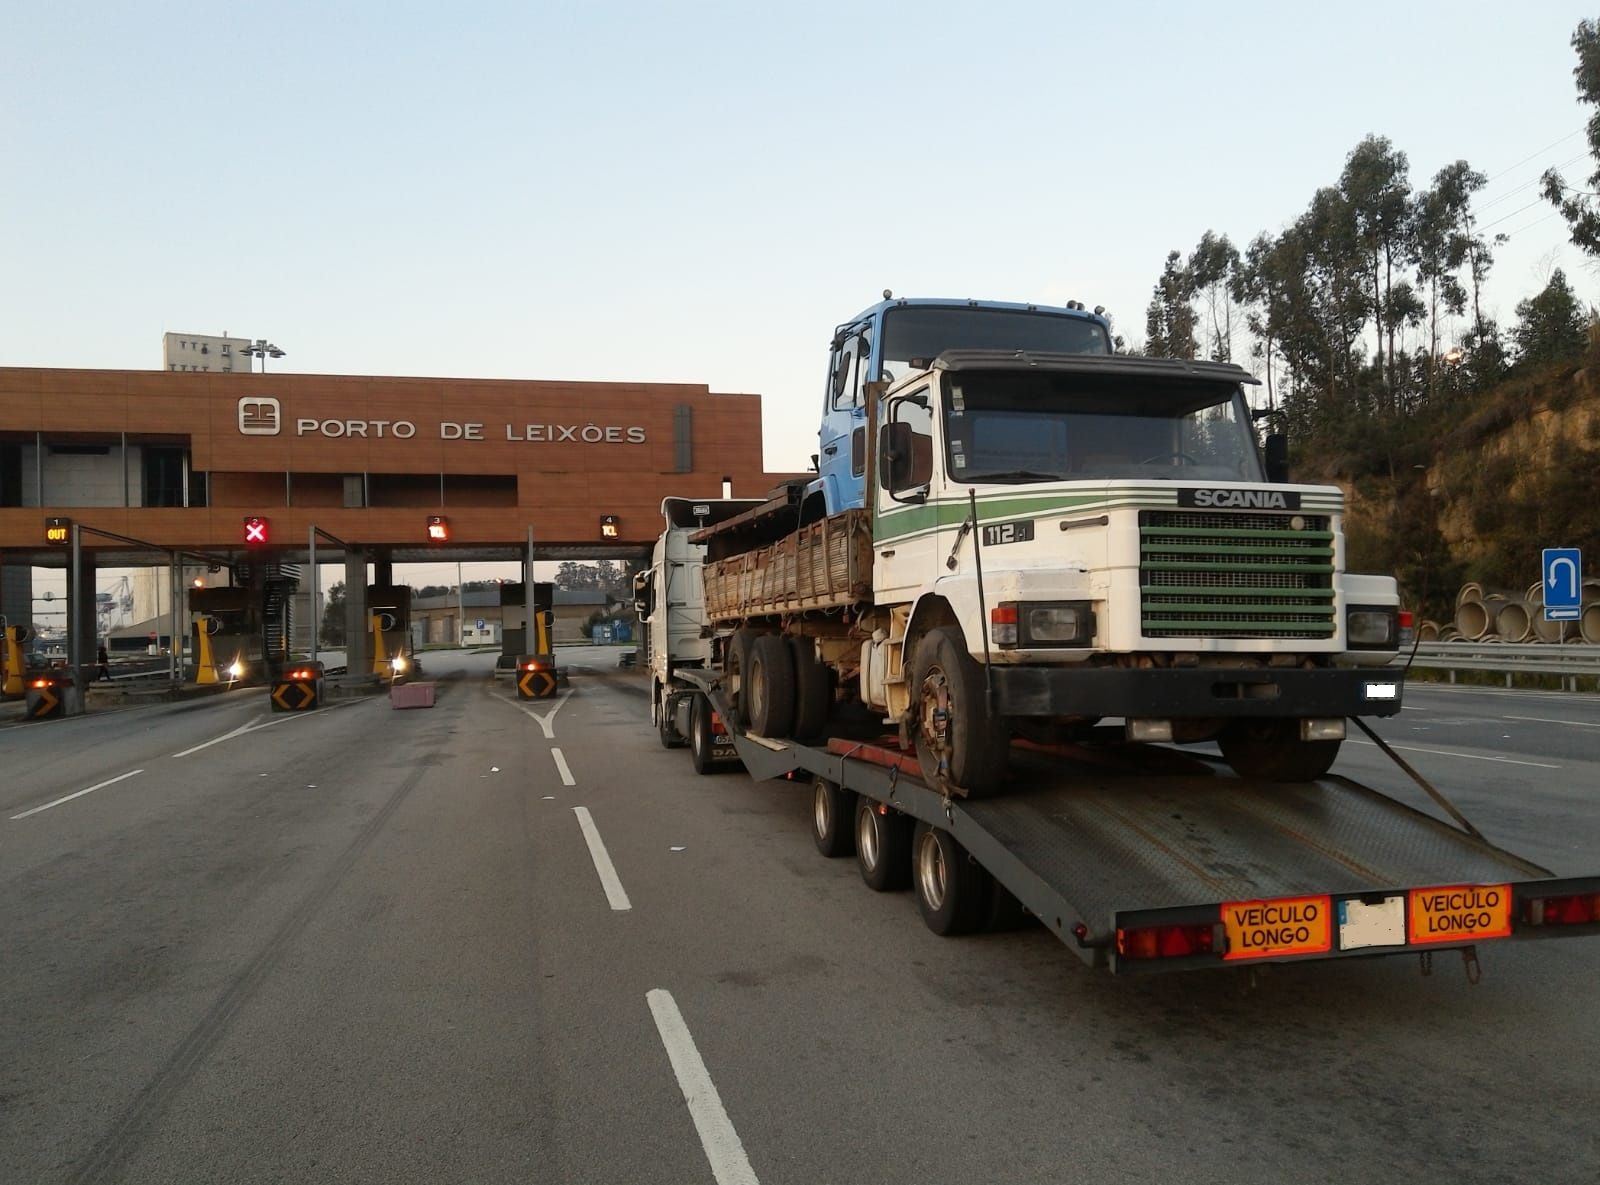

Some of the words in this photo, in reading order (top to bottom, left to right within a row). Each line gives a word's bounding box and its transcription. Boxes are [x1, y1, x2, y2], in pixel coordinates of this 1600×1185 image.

[297, 418, 416, 439] PORTO
[440, 422, 485, 440] DE
[1194, 489, 1287, 509] SCANIA
[53, 518, 59, 526] 1
[47, 528, 66, 540] OUT
[987, 523, 1015, 545] 112
[712, 749, 737, 757] DA
[1422, 891, 1500, 913] VEICULO
[1235, 904, 1318, 927] VEICULO
[1429, 912, 1492, 933] LONGO
[1242, 926, 1310, 948] LONGO
